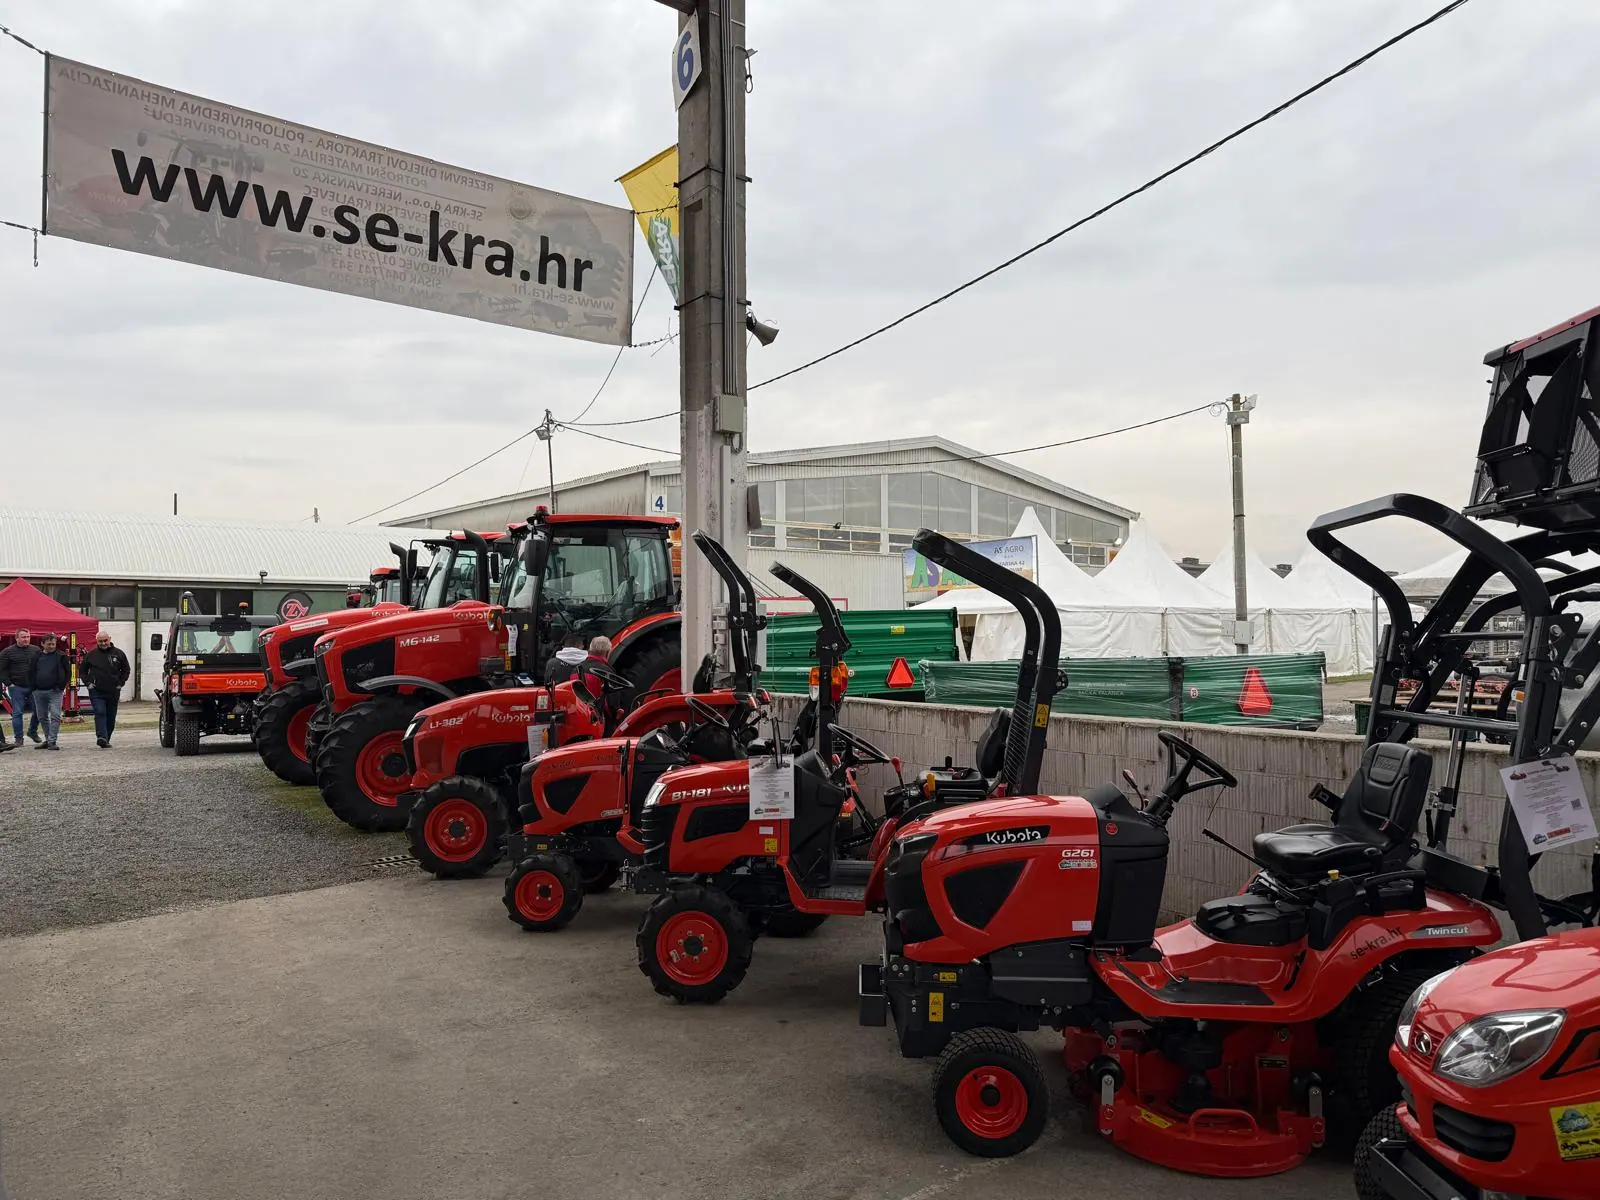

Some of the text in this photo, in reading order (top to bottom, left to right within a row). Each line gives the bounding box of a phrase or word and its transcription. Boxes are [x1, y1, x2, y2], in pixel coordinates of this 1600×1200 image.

[677, 30, 694, 91] 6
[112, 148, 593, 292] www.se-kra.hr
[655, 495, 664, 510] 4
[1005, 545, 1025, 553] AGRO
[400, 634, 440, 648] M6-142
[226, 679, 258, 687] Kubota
[491, 712, 531, 723] Kubota
[986, 827, 1041, 845] Kubota
[1061, 849, 1095, 858] G261
[1351, 926, 1401, 960] se-kra.hr
